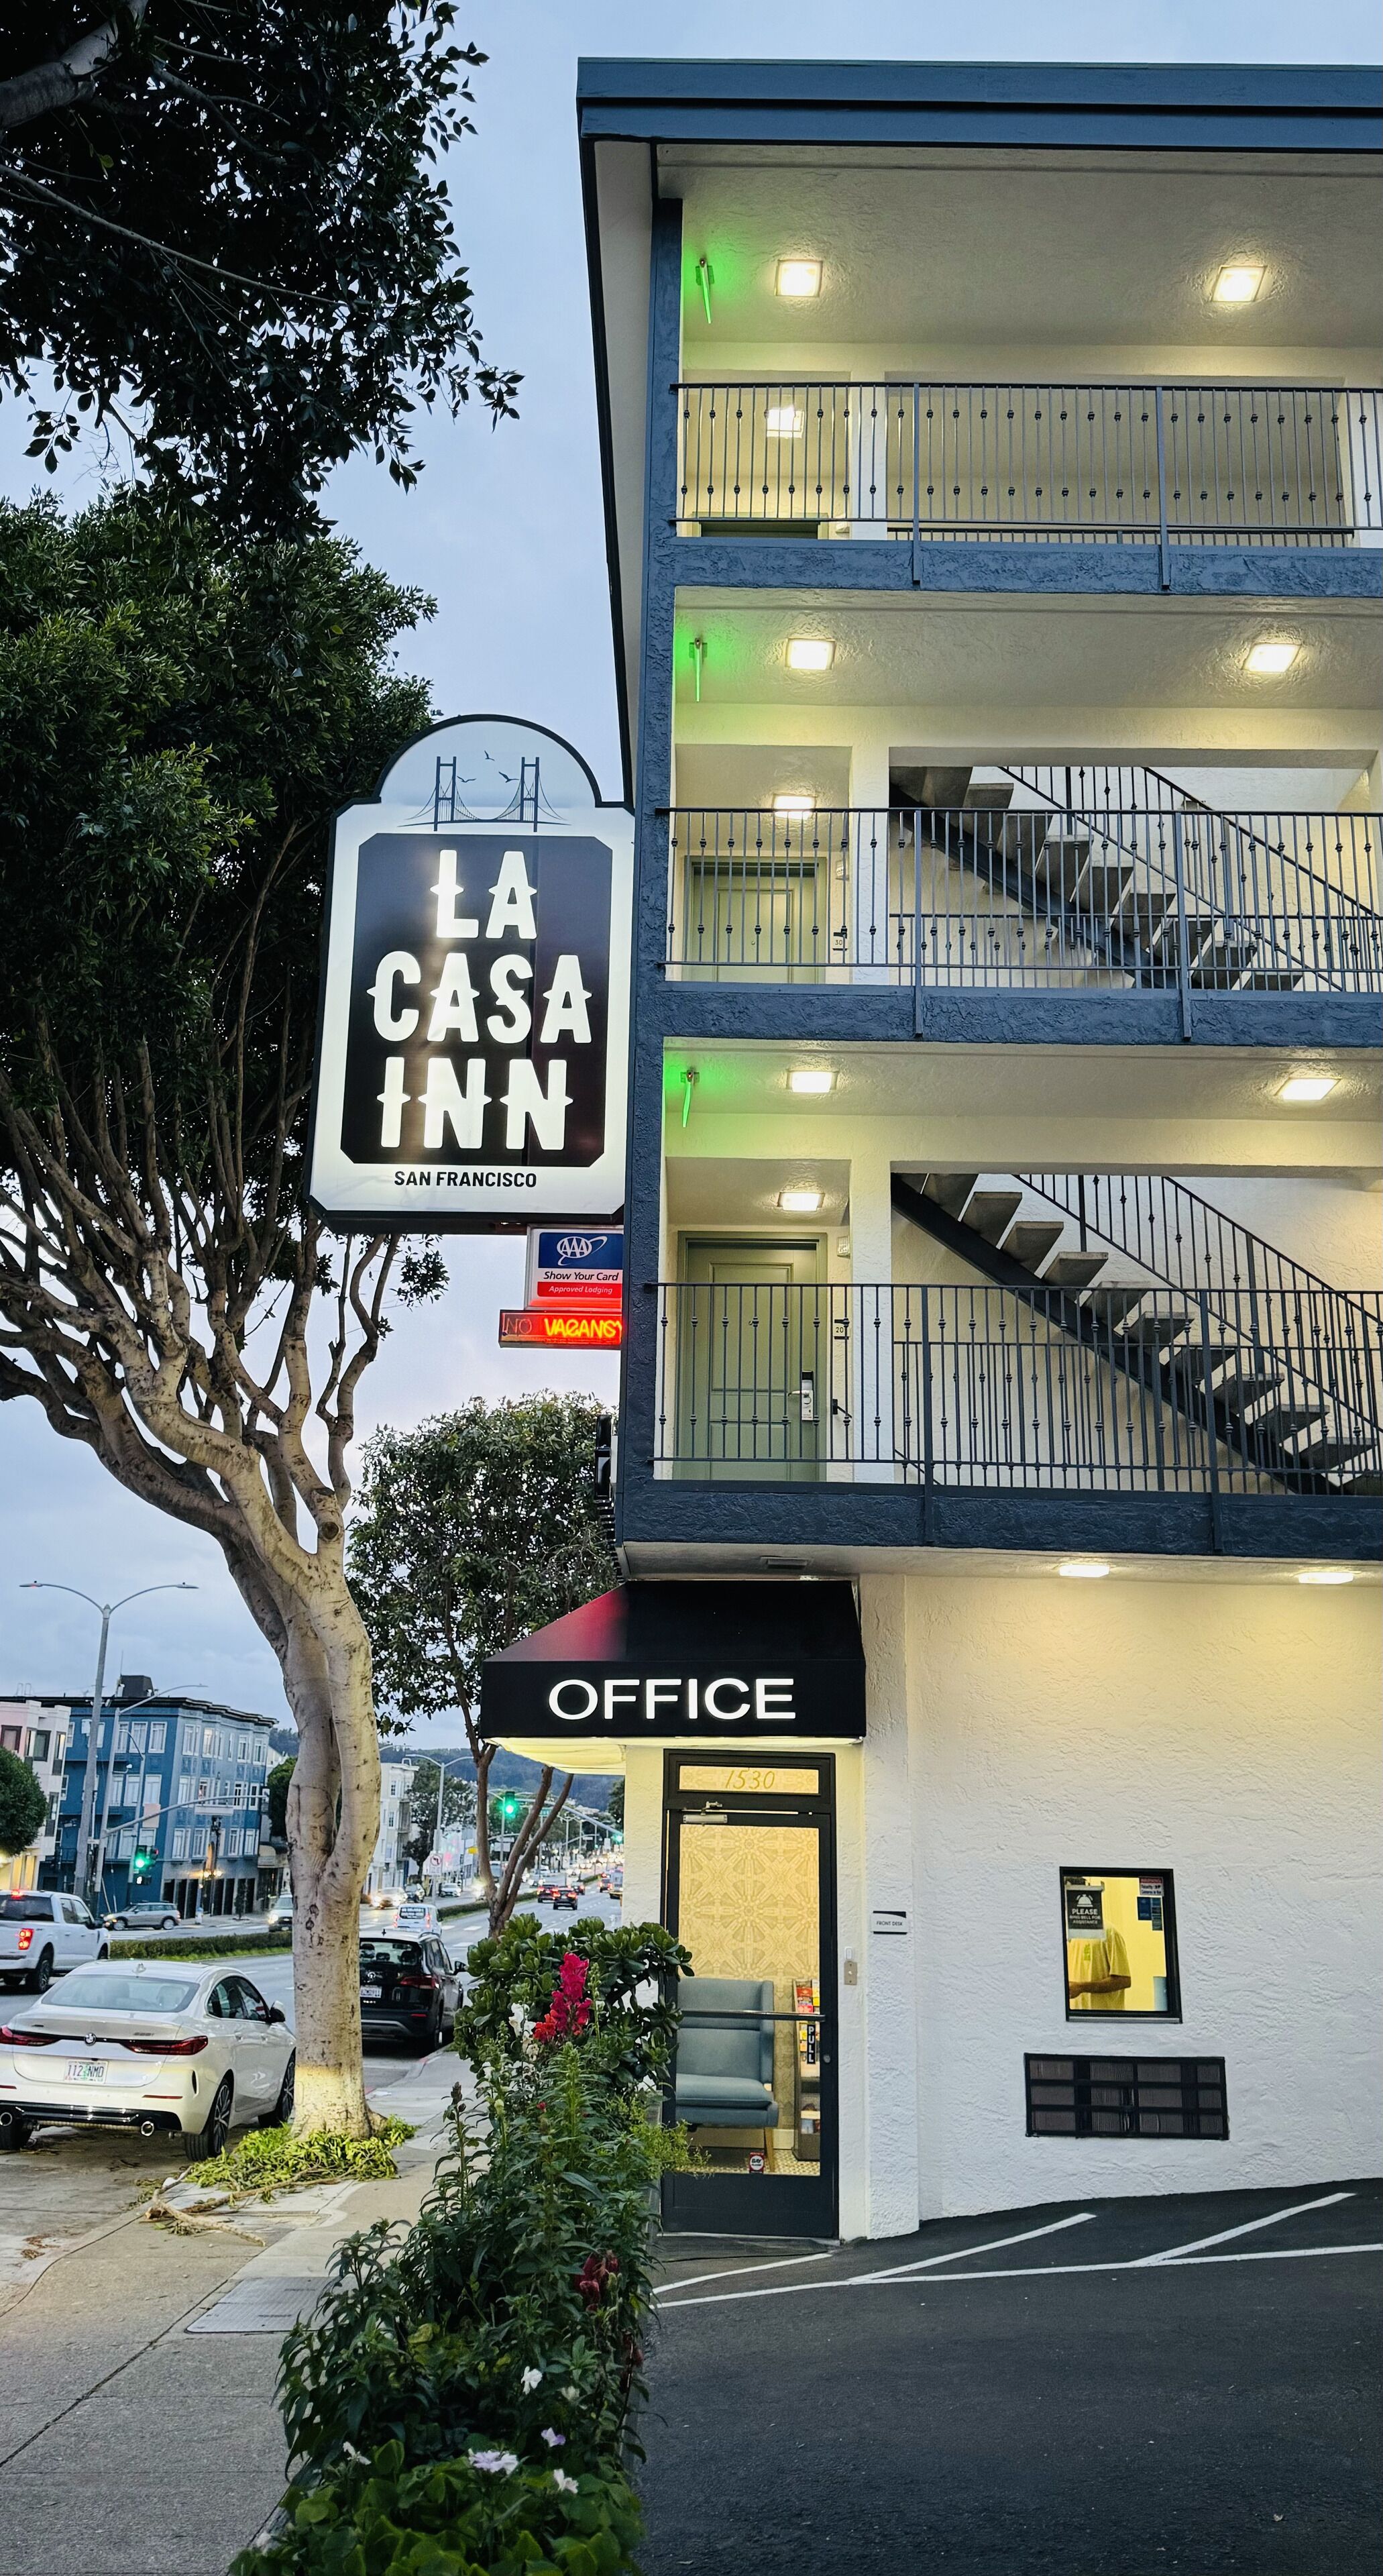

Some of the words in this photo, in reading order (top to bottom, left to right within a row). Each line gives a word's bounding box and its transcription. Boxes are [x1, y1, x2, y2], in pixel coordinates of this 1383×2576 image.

[430, 849, 537, 939] LA
[366, 951, 592, 1044] CASA
[376, 1057, 573, 1150] INN
[394, 1171, 431, 1185] SAN
[436, 1171, 537, 1187] FRANCISCO
[561, 1238, 588, 1258] AAA
[543, 1271, 571, 1280] Show
[574, 1272, 595, 1281] Your
[596, 1272, 619, 1281] Card
[549, 1286, 583, 1294] Approved
[585, 1287, 612, 1295] Lodging
[506, 1318, 533, 1334] NO
[549, 1678, 796, 1720] OFFICE
[725, 1770, 775, 1790] 1530
[68, 2065, 83, 2076] 112
